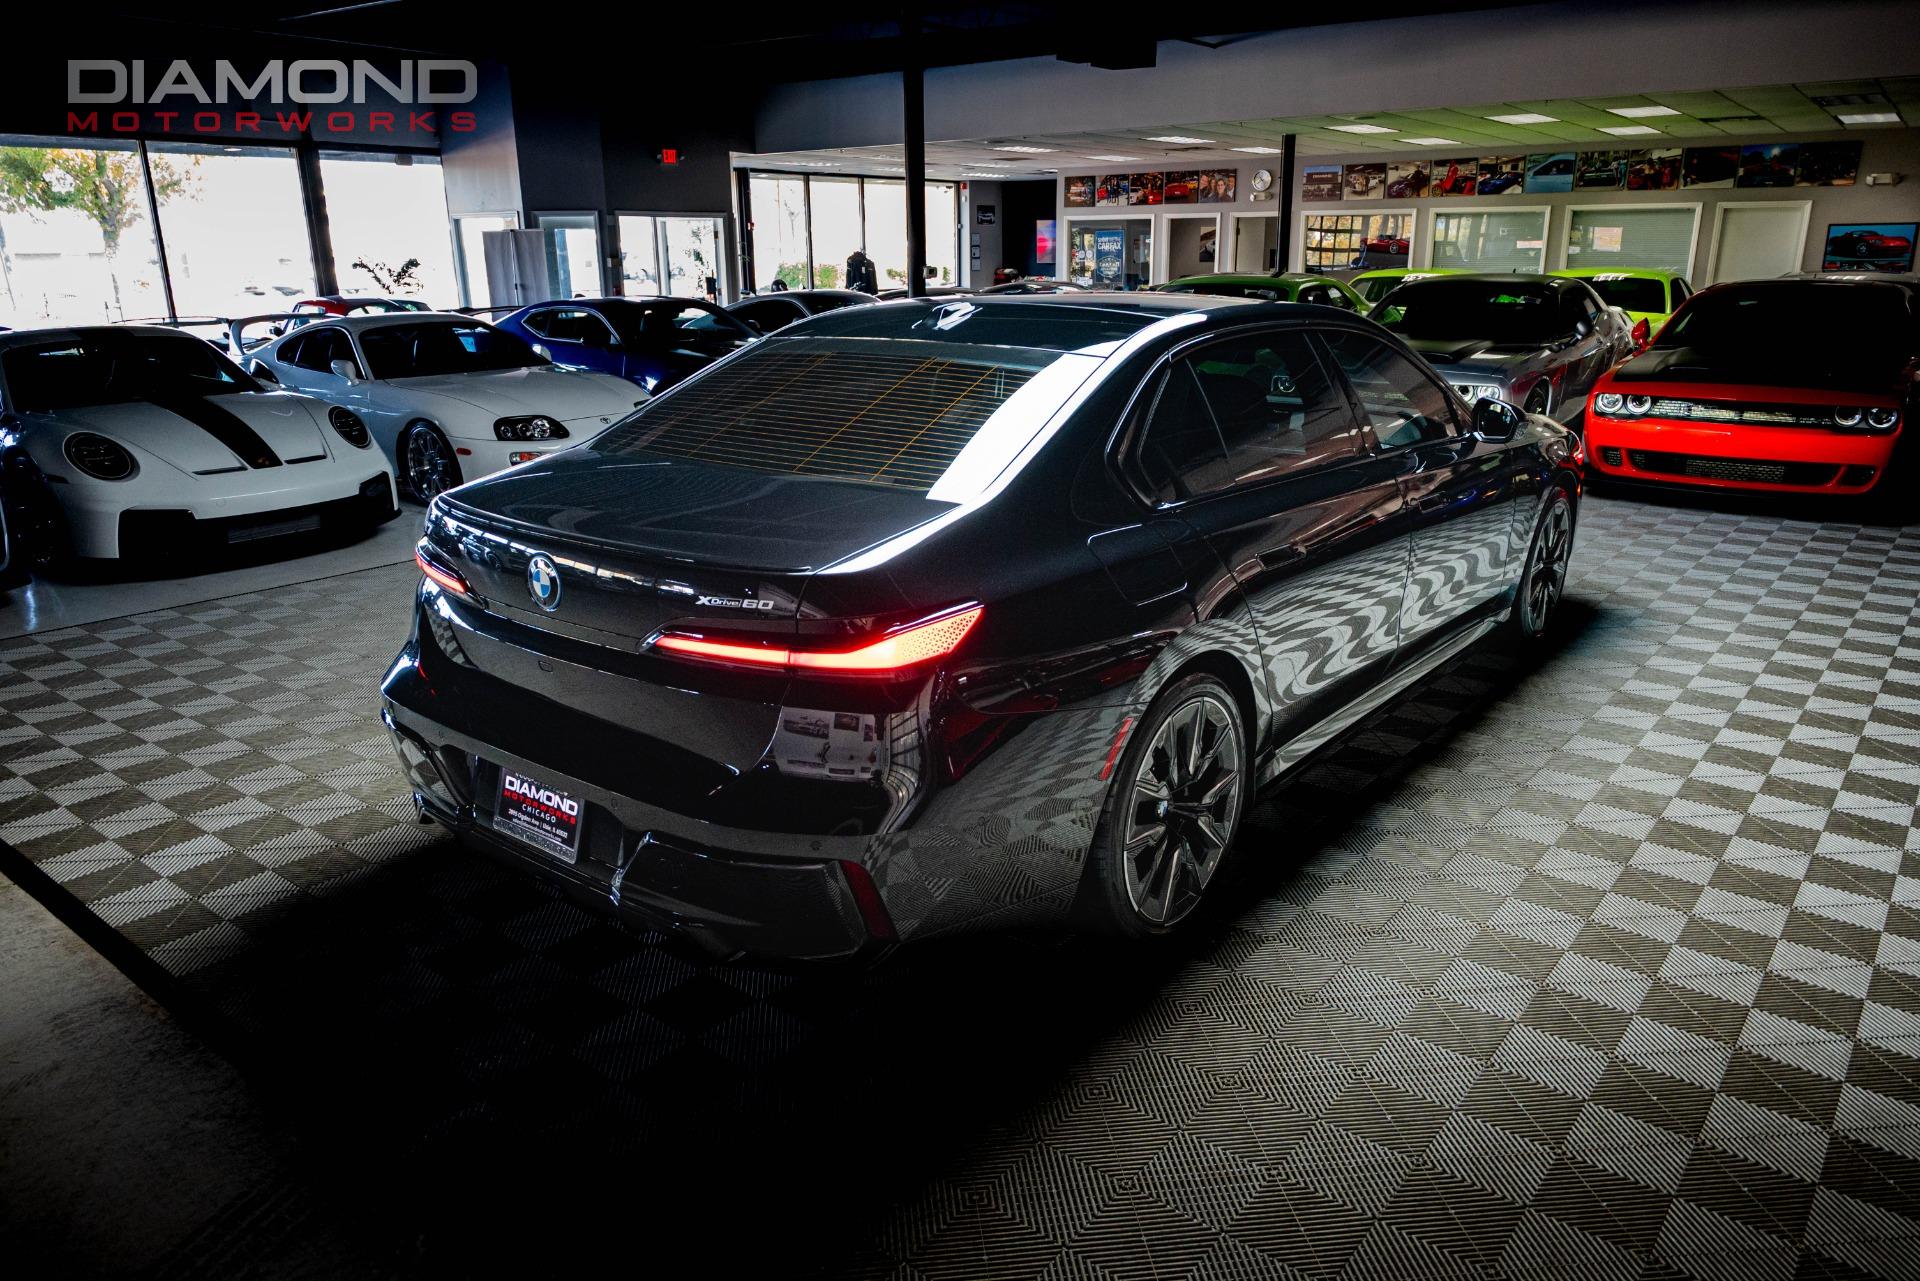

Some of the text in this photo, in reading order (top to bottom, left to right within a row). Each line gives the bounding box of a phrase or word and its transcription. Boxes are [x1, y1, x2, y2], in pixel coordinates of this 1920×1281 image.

[1097, 242, 1121, 250] CARFAX
[503, 789, 577, 825] MOTORWORKS
[504, 775, 578, 816] DIAMOND
[521, 803, 556, 823] CHICAGO
